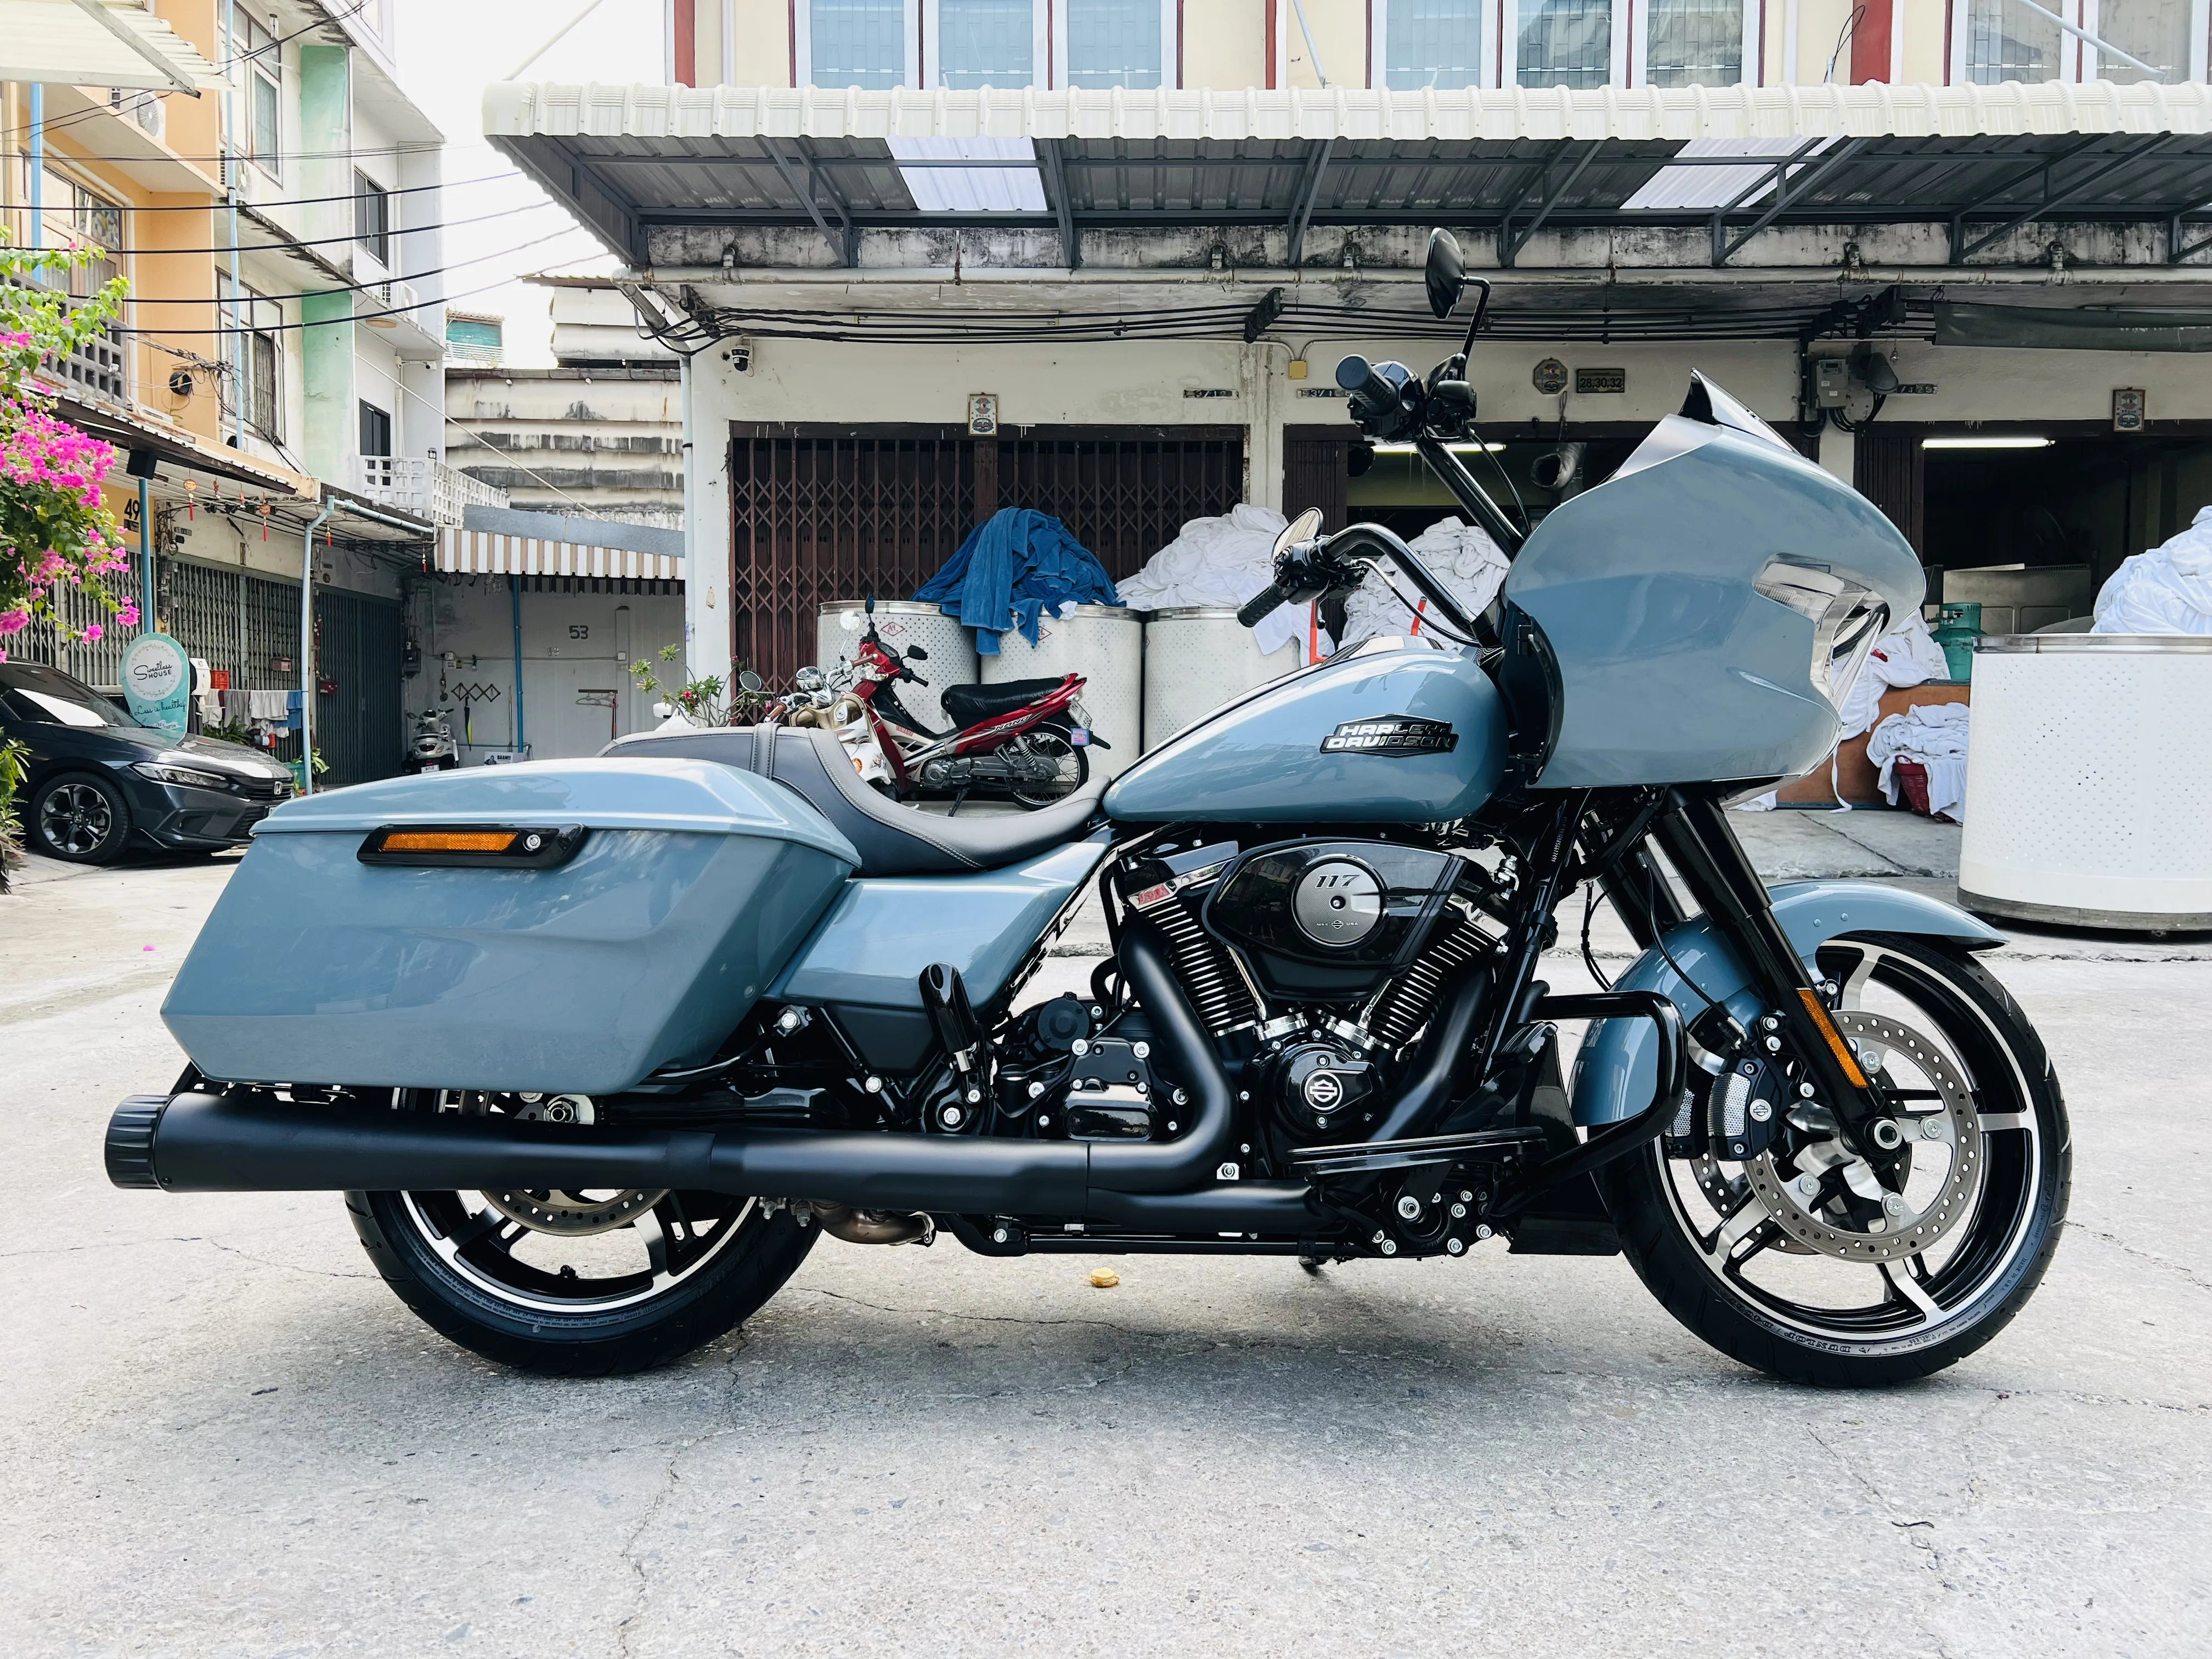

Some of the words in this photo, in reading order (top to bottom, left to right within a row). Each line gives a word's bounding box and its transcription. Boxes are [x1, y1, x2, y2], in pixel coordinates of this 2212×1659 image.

[124, 498, 140, 520] 49
[568, 625, 589, 640] 53
[134, 661, 172, 680] Sweetless
[148, 670, 172, 679] HOUSE
[134, 705, 153, 716] Less
[161, 699, 187, 712] healthy
[1325, 736, 1451, 748] DAVIDSON
[1314, 874, 1361, 889] 117
[1784, 1331, 1852, 1353] DUNLOP
